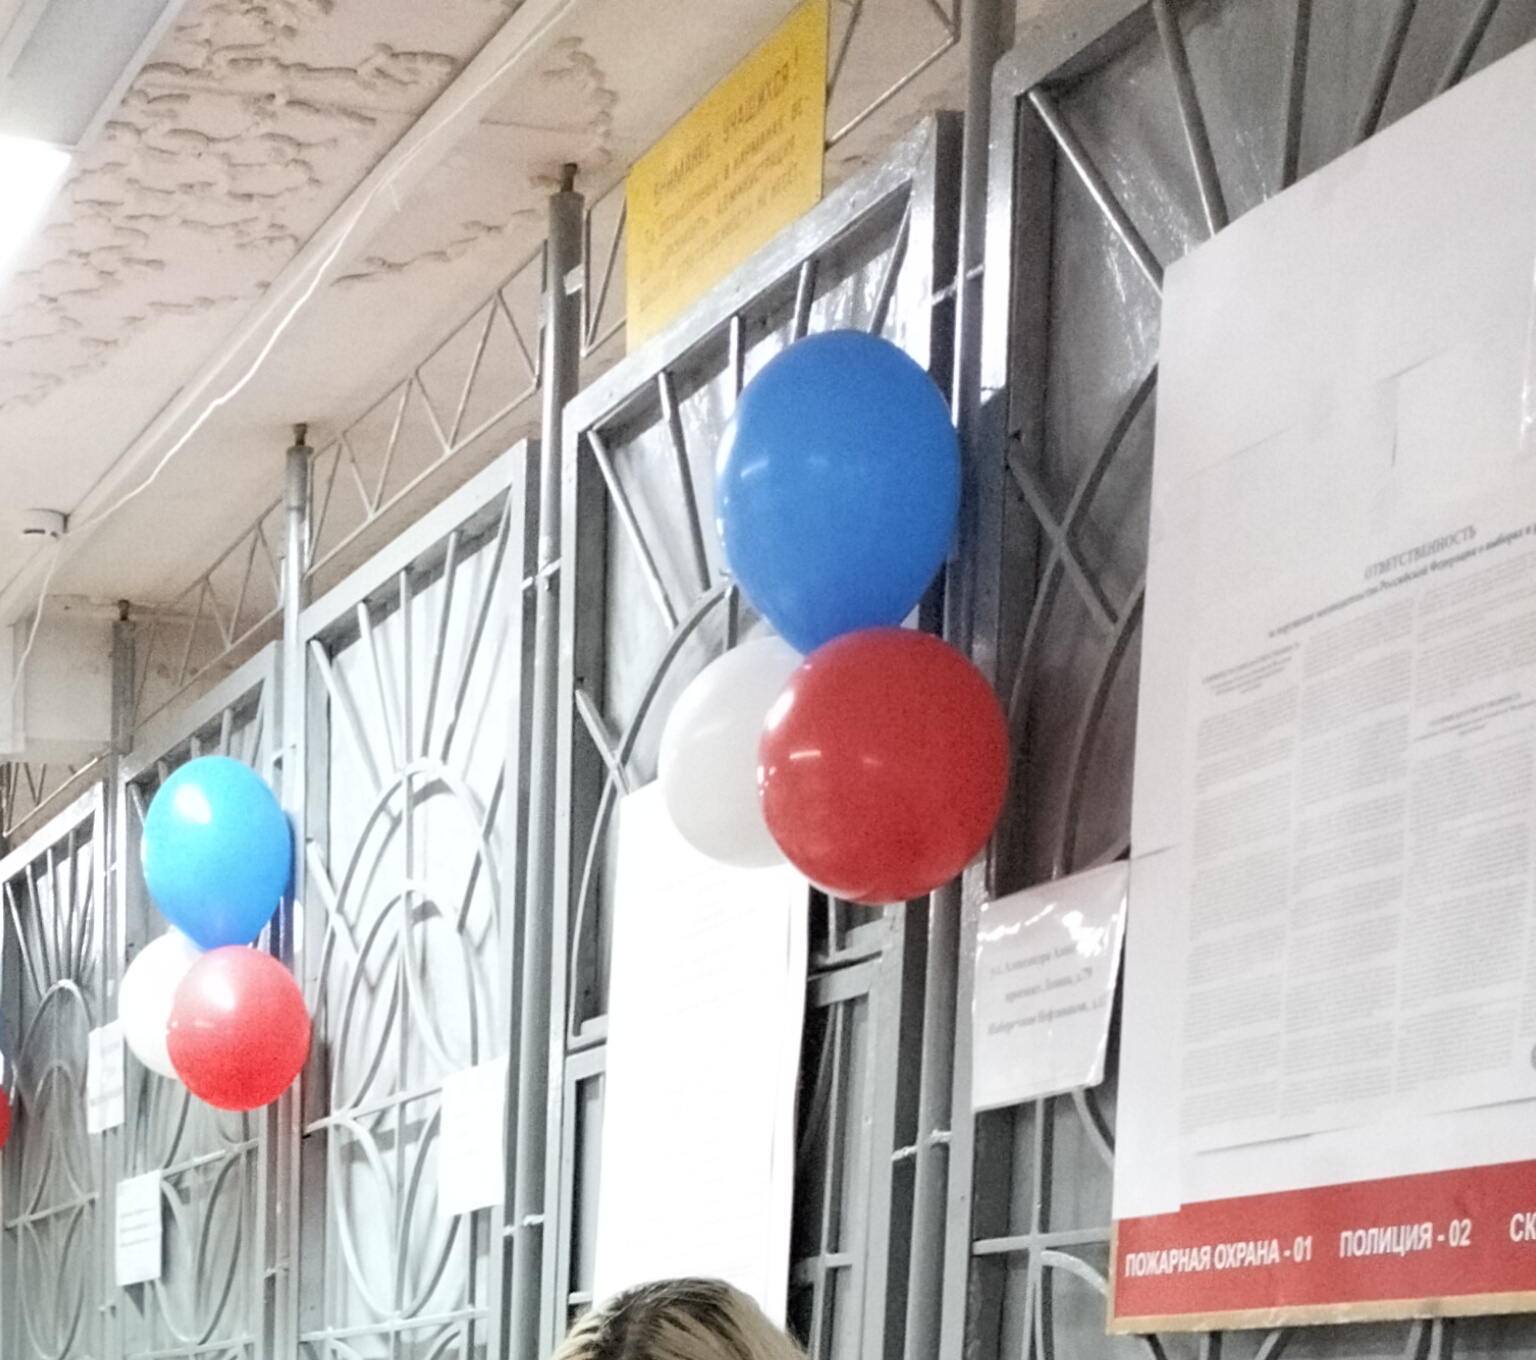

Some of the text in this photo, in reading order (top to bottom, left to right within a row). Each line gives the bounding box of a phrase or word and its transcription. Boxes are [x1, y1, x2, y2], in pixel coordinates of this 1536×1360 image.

[1363, 525, 1477, 580] ОТВЕТСТВЕННОСТЬ
[1124, 1245, 1212, 1278] ПОЖАРНАЯ
[1213, 1238, 1280, 1271] ОХРАНА
[1339, 1221, 1433, 1258] ПОЛИЦИЯ
[1448, 1218, 1472, 1248] 02
